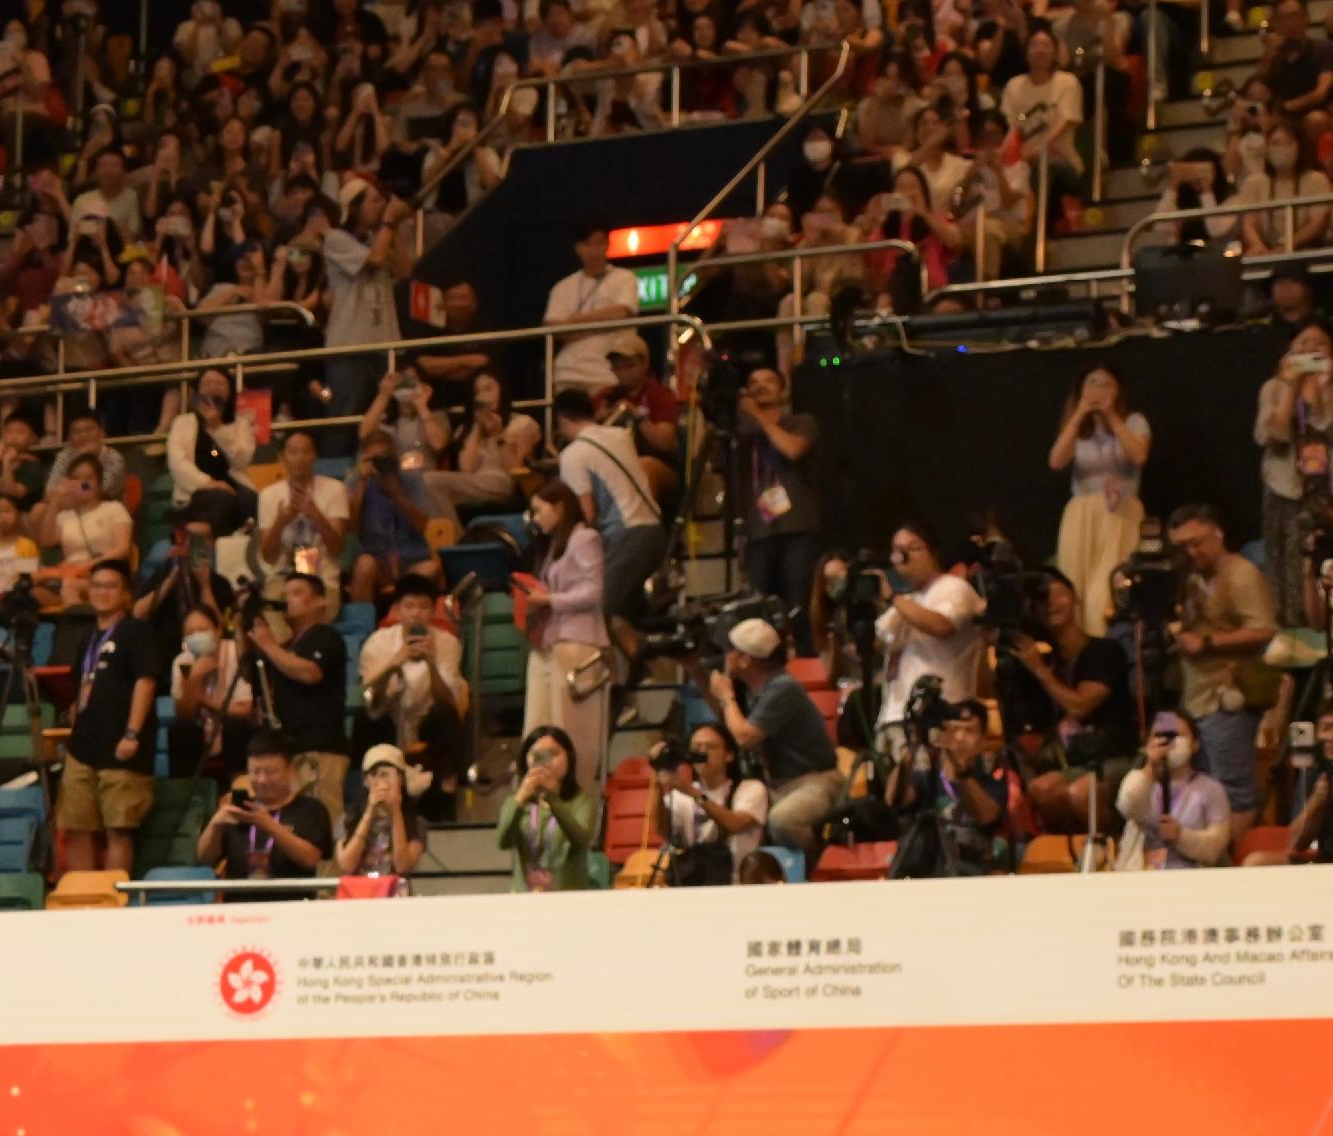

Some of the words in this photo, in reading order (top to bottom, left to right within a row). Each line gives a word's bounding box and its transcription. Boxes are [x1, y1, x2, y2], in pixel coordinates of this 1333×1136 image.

[744, 963, 799, 978] General
[802, 960, 903, 976] Administration
[1117, 953, 1157, 970] Hong
[1160, 952, 1198, 968] Kong
[1201, 951, 1232, 964] And
[1235, 950, 1285, 963] Macao
[297, 976, 329, 990] Hong
[332, 976, 365, 990] Kong
[368, 973, 414, 988] Special
[417, 971, 507, 986] Administrative
[510, 970, 553, 986] Region
[1169, 972, 1208, 988] State
[1210, 971, 1267, 986] Council
[463, 988, 502, 1002] China
[762, 985, 801, 1000] Sport
[821, 982, 863, 997] China
